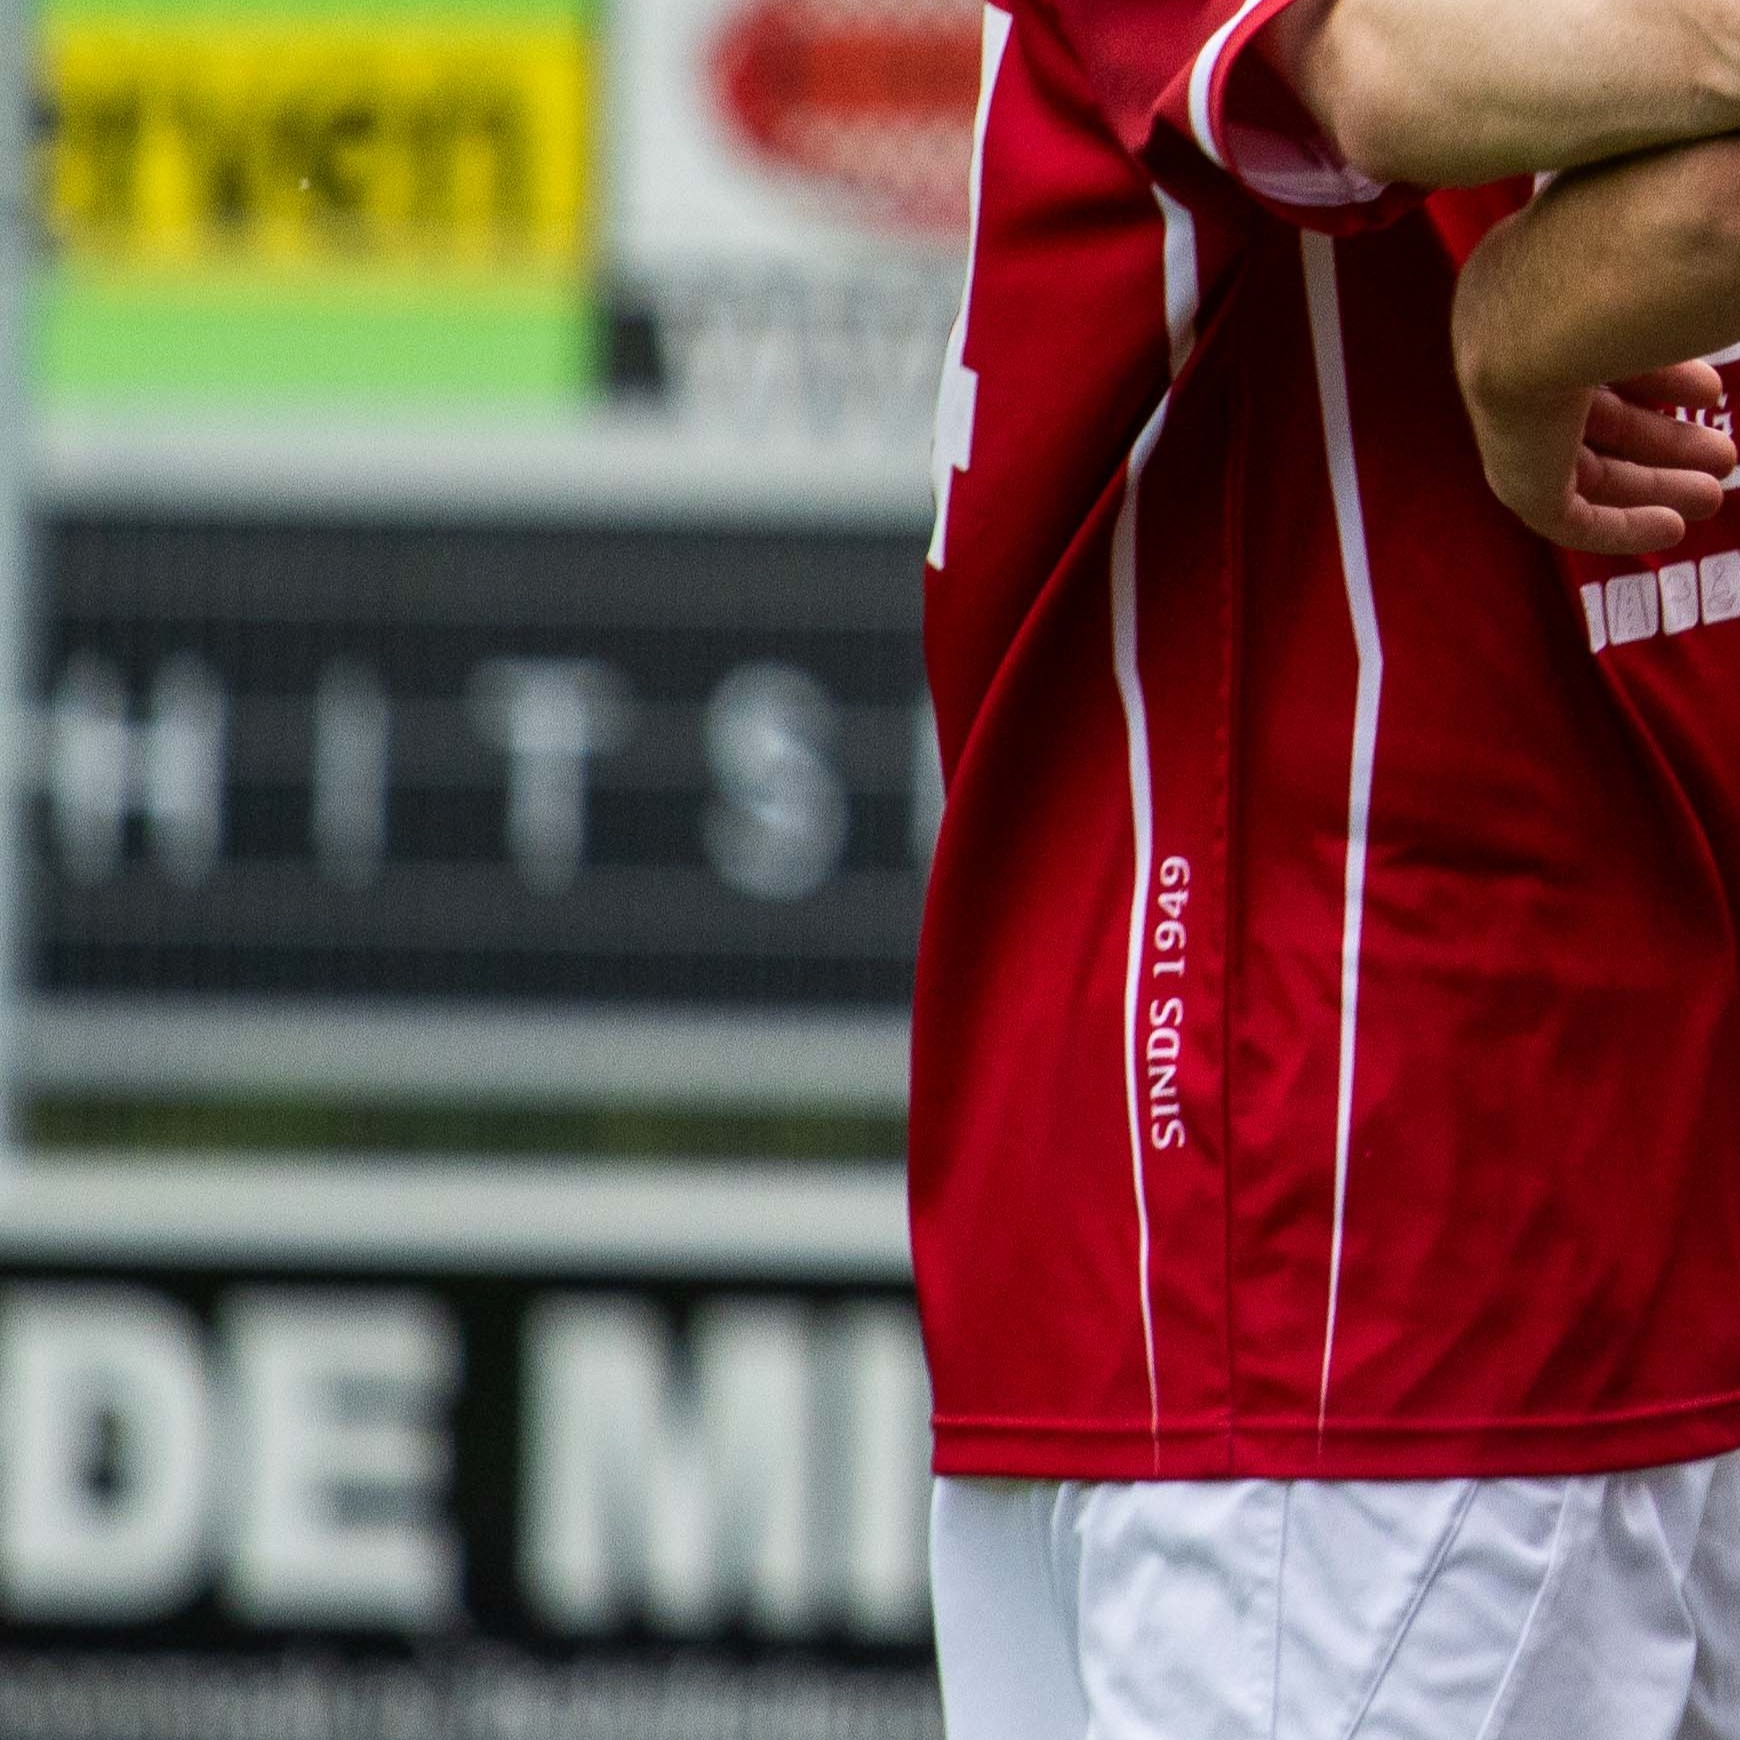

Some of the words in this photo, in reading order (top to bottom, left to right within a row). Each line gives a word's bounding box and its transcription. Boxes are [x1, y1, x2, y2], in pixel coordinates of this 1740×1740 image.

[1153, 856, 1191, 978] 1949
[1146, 996, 1185, 1149] SINDS
[0, 1288, 462, 1626] DE
